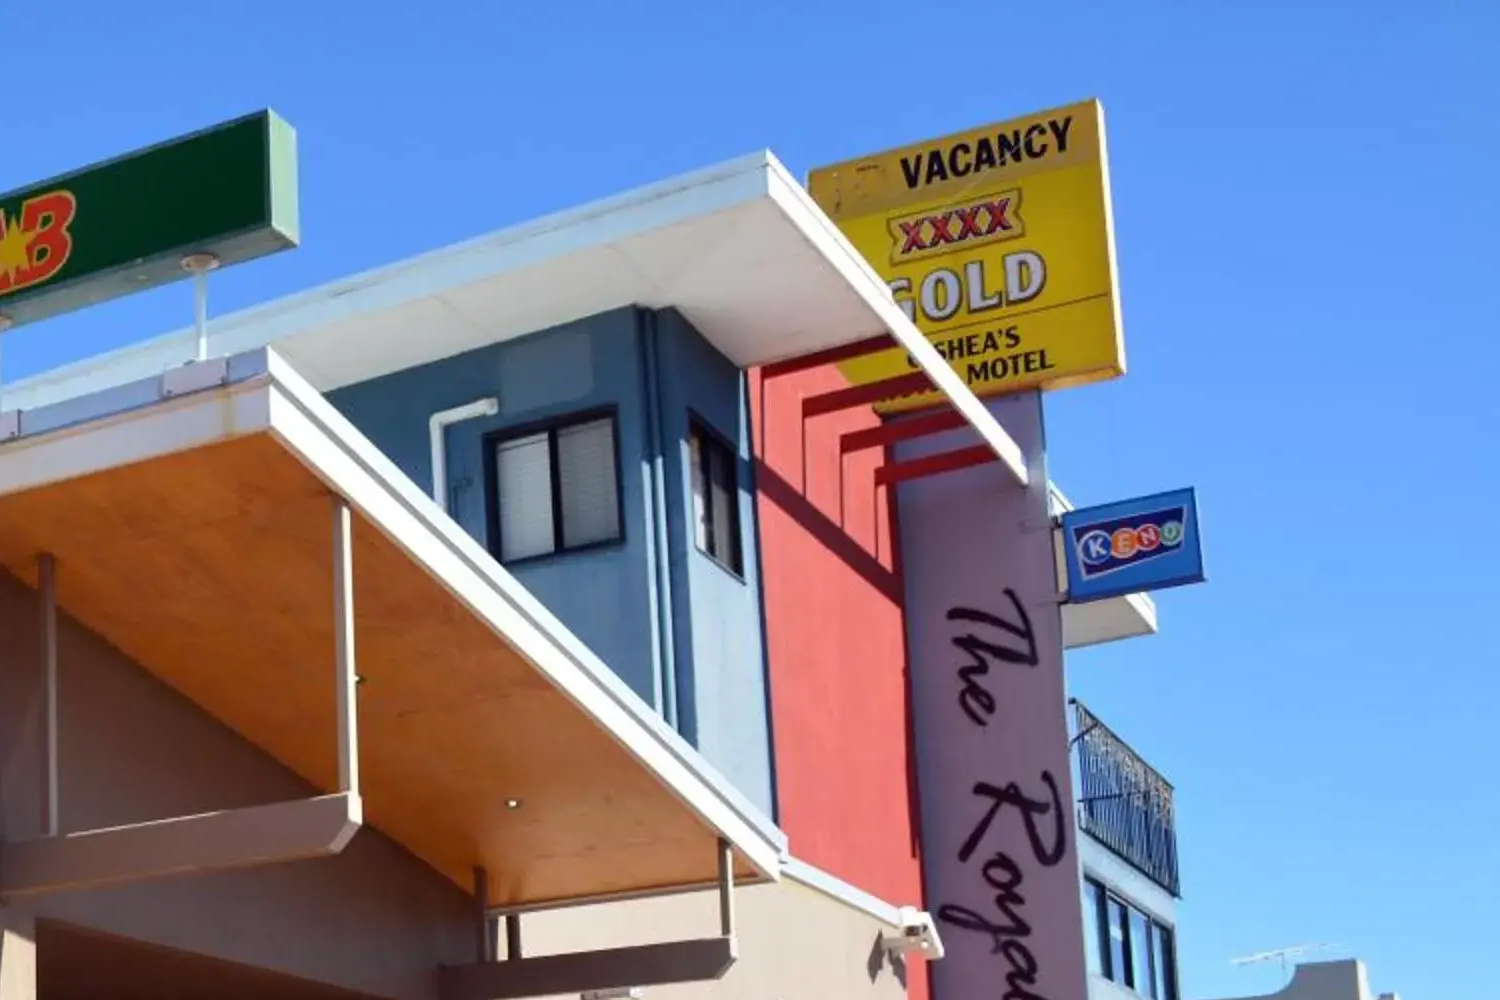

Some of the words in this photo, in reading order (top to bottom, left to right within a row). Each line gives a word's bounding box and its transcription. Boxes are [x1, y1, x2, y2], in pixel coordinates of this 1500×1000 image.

[901, 117, 1072, 189] VACANCY
[900, 198, 1013, 255] XXXX
[966, 349, 1055, 385] MOTEL
[1083, 521, 1180, 562] KENO
[947, 588, 1038, 726] The
